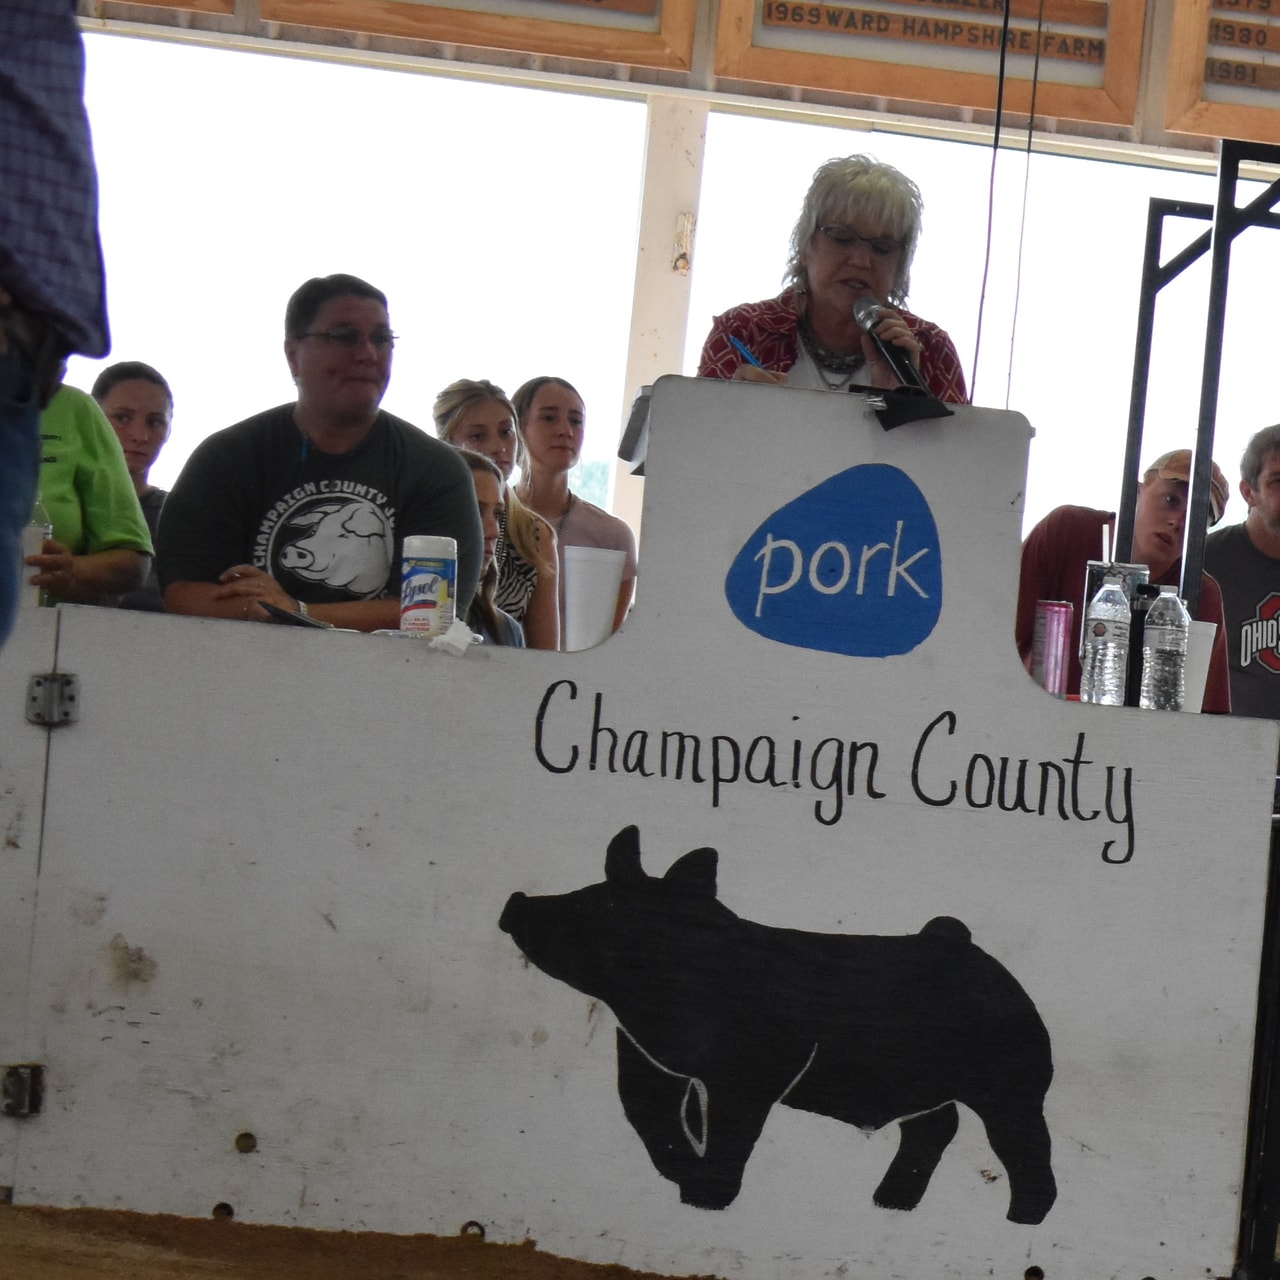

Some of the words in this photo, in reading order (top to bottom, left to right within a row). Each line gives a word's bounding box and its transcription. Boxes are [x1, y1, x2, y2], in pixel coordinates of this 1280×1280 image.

[766, 3, 821, 26] 1969
[827, 8, 891, 34] WARD
[1210, 23, 1268, 47] 1980
[253, 481, 318, 568] CHAMPAIGN
[752, 519, 930, 619] pork
[533, 678, 888, 828] Champaign
[910, 709, 1136, 867] County
